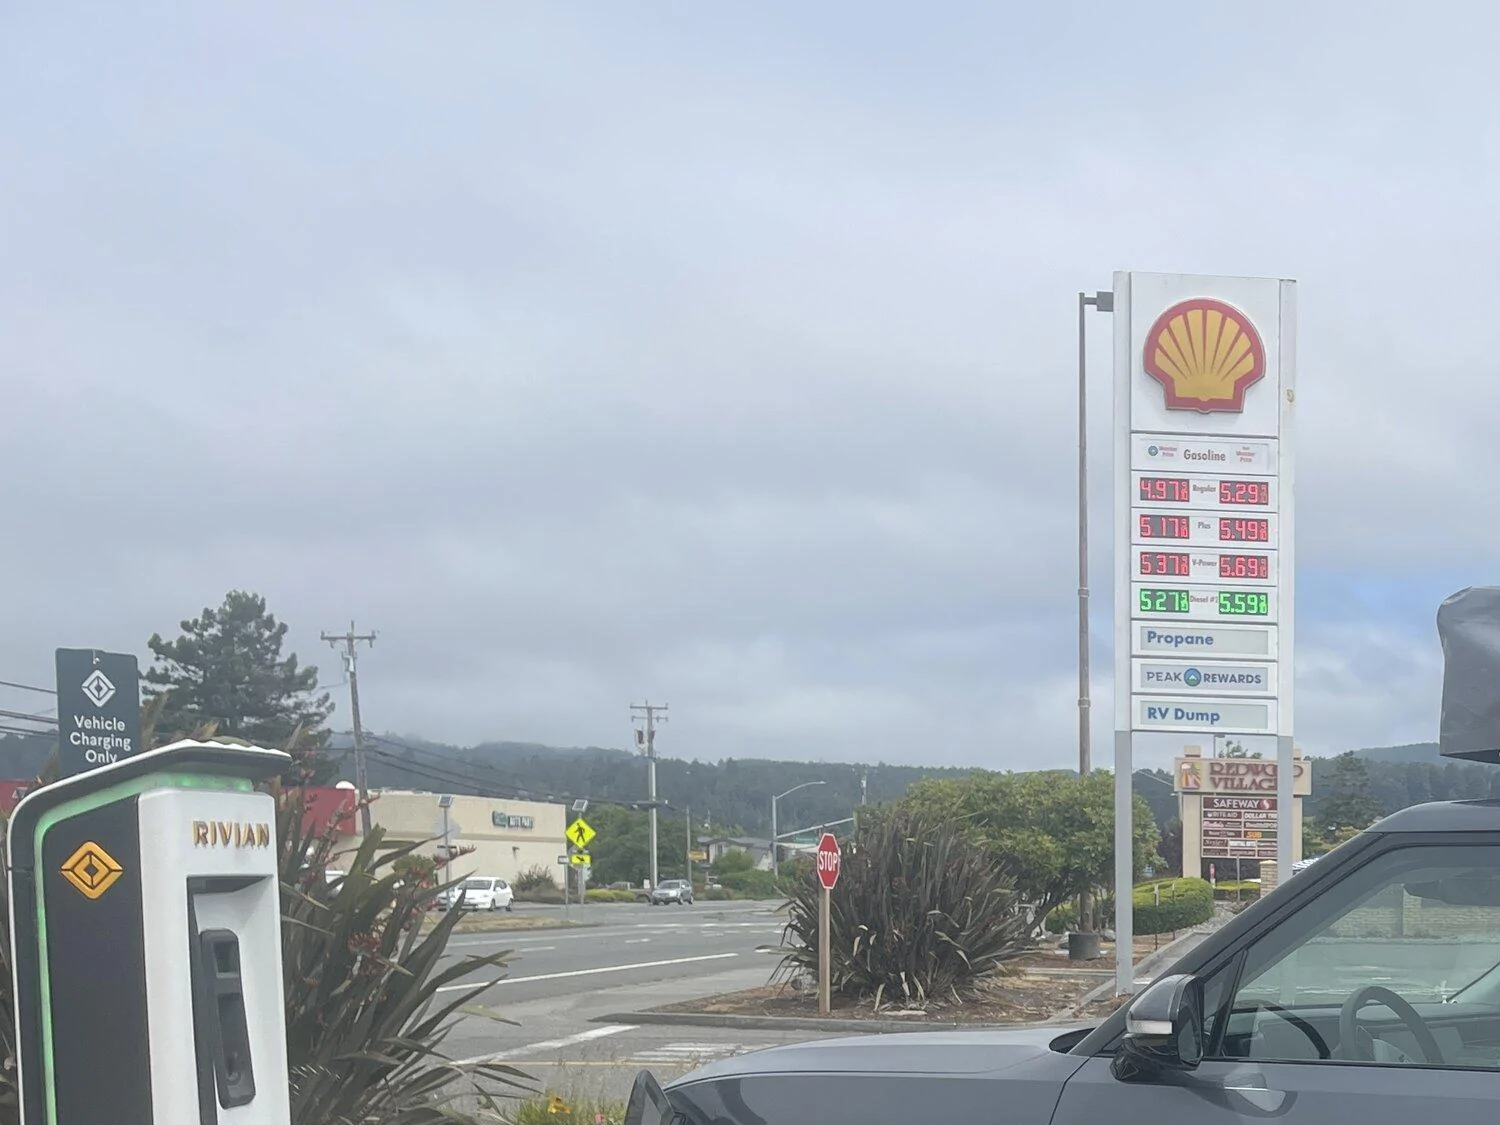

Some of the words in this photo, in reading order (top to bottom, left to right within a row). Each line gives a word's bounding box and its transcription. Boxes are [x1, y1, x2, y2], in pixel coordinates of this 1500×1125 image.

[1184, 449, 1226, 461] Gasoline
[1190, 595, 1209, 603] Diesel
[1147, 631, 1214, 647] Propane
[1146, 672, 1182, 682] PEAK
[1203, 674, 1262, 684] REWARDS
[74, 715, 125, 731] Vehicle
[1147, 707, 1169, 720] RV
[1174, 708, 1220, 725] Dump
[70, 732, 131, 751] Charging
[85, 749, 117, 763] Only
[1209, 762, 1304, 778] REDWOD
[1213, 799, 1259, 808] SAFEWAY
[192, 820, 270, 848] RIVIAN
[819, 851, 838, 871] STOP
